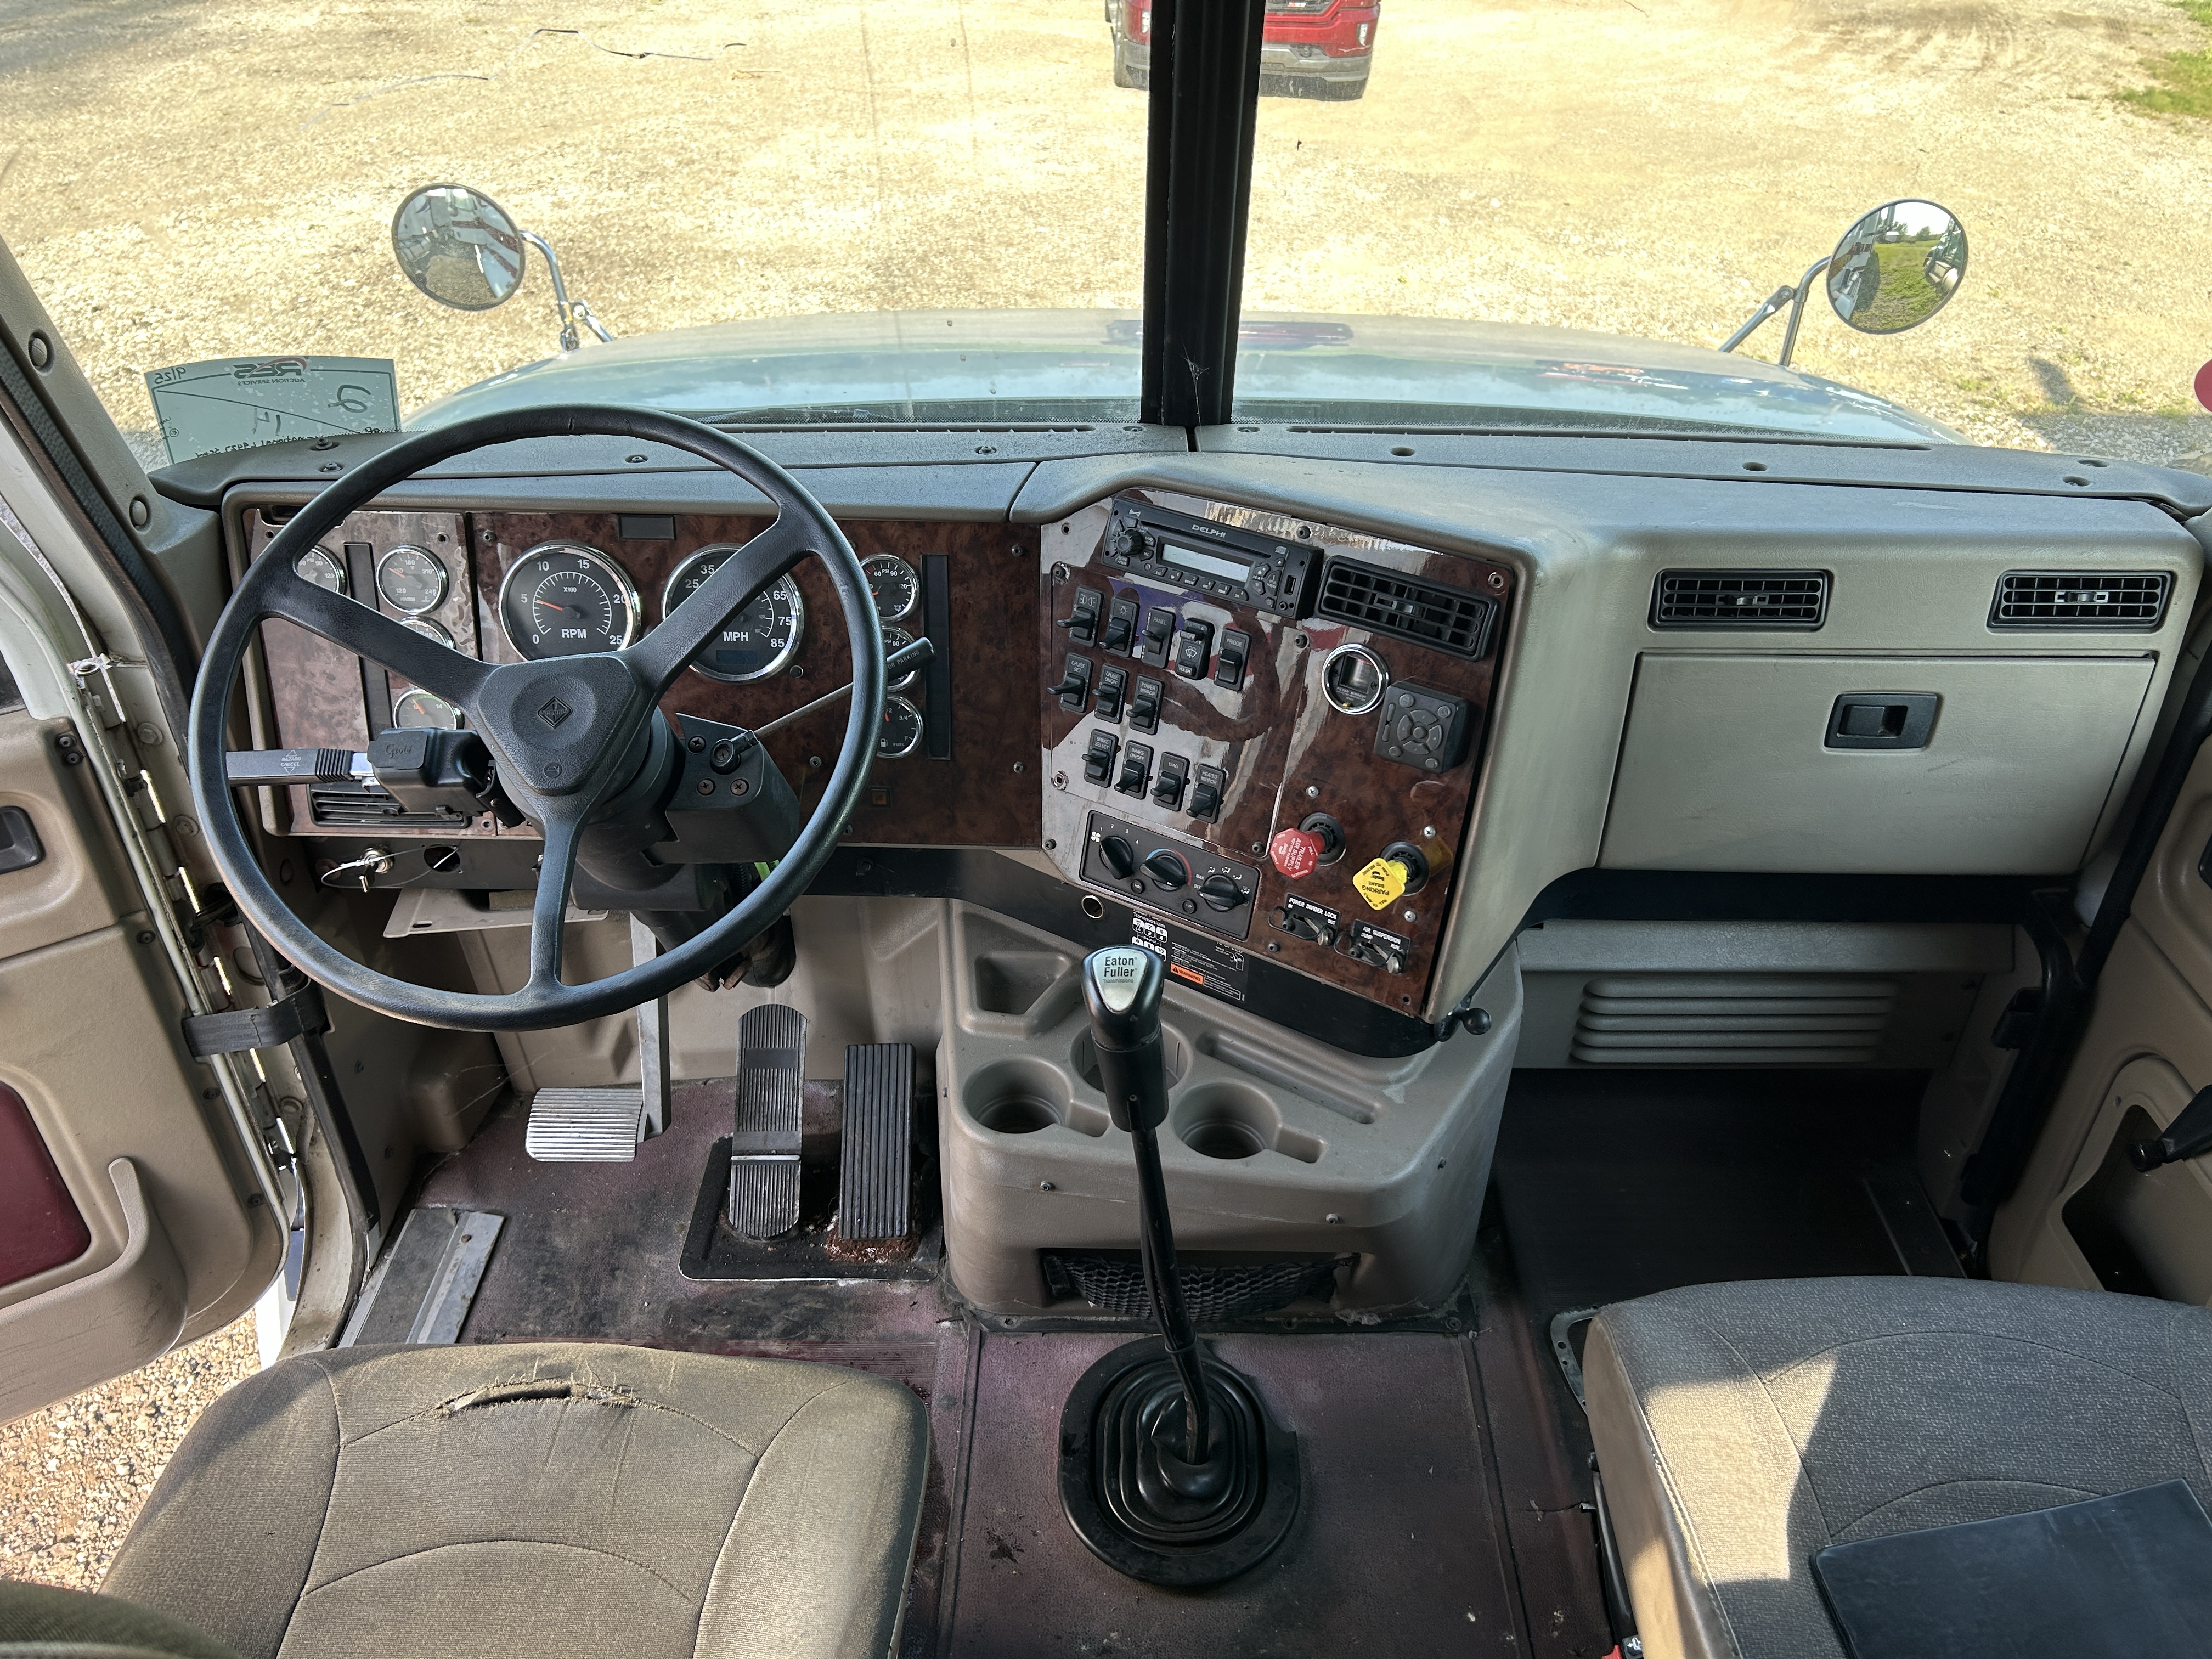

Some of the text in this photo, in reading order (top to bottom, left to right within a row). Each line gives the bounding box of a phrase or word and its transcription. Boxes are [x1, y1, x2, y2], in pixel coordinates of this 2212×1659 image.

[1192, 524, 1226, 538] DELPHI
[537, 559, 590, 572] 10 15
[700, 565, 715, 575] 35
[685, 579, 699, 589] 25
[521, 593, 528, 603] 5
[613, 594, 625, 604] 20
[772, 590, 787, 601] 65
[777, 616, 792, 626] 75
[1153, 617, 1167, 626] PANEL
[532, 634, 623, 645] 0 25
[561, 628, 749, 642] RPM MPH
[770, 637, 785, 648] 85
[1226, 638, 1242, 648] FRIDGE
[896, 650, 921, 665] PARKING
[1071, 660, 1086, 669] CRUISE
[1178, 666, 1191, 674] WASH
[1105, 671, 1119, 680] CRUISE
[1141, 682, 1156, 691] POWER
[1139, 687, 1155, 697] MIRROR
[1094, 741, 1109, 750] SELECT
[1096, 736, 1109, 745] BRAKE
[1131, 747, 1145, 756] BRAKE
[1202, 771, 1218, 780] HEATED
[1286, 849, 1298, 872] SUPPLY
[1293, 846, 1306, 870] TRAILER
[1362, 885, 1390, 896] PARKING
[1289, 897, 1305, 908] POWER
[1324, 910, 1338, 921] LOCK
[1105, 956, 1135, 966] Eaton
[1104, 966, 1135, 978] Fuller
[1178, 968, 1201, 982] WARNING
